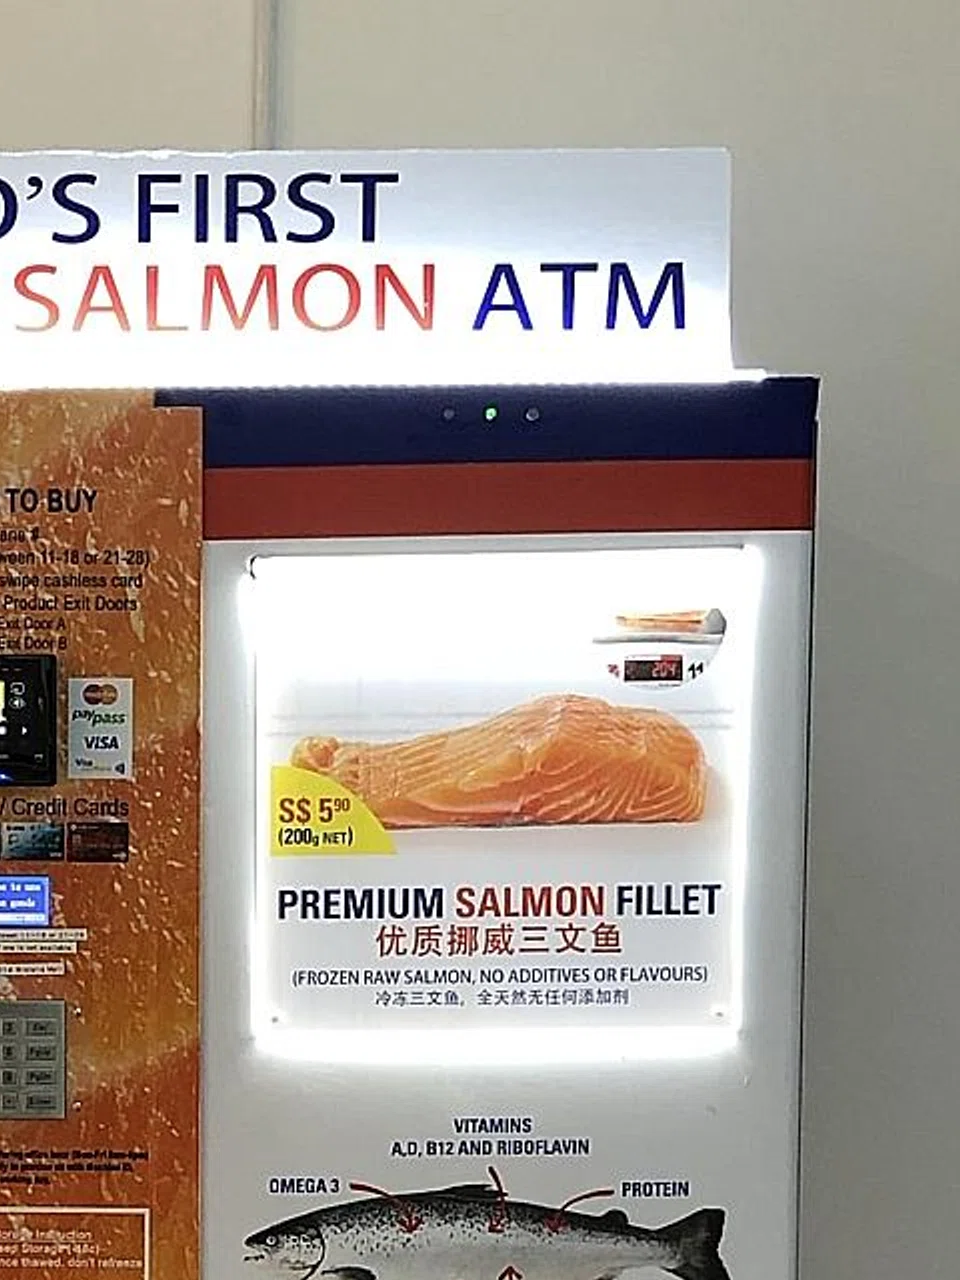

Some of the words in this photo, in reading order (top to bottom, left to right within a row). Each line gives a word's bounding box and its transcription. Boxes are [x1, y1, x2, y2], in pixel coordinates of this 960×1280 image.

[138, 172, 399, 244] FIRST
[15, 264, 433, 333] SALMON
[473, 262, 686, 332] ATM
[9, 488, 40, 513] TO
[48, 489, 97, 513] BUY
[41, 550, 79, 565] 11-18
[84, 553, 98, 564] or
[103, 550, 149, 566] 21-28)
[0, 575, 39, 589] swipe
[44, 573, 106, 587] cashless
[111, 573, 143, 587] card
[4, 595, 57, 611] Product
[64, 595, 91, 611] Exit
[95, 595, 137, 611] Doors
[84, 736, 119, 749] VISA
[0, 799, 5, 815] /
[12, 798, 66, 816] Credit
[74, 799, 129, 816] Cards
[323, 829, 353, 845] NET)
[278, 887, 443, 920] PREMIUM
[456, 886, 604, 917] SALMON
[616, 884, 721, 915] FILLET
[376, 924, 622, 957] 优质挪威三文鱼
[292, 969, 359, 986] (FROZEN
[363, 969, 400, 985] RAW
[404, 968, 475, 985] SALMON,
[480, 968, 503, 984] NO
[508, 968, 589, 984] ADDITIVES
[594, 967, 616, 983] OR
[621, 966, 707, 983] FLAVOURS)
[454, 1118, 532, 1133] VITAMINS
[426, 1140, 454, 1156] B12
[458, 1140, 492, 1155] AND
[497, 1139, 590, 1155] RIBOFLAVIN
[270, 1178, 327, 1193] OMEGA
[330, 1178, 339, 1193] 3
[622, 1182, 688, 1197] PROTEIN
